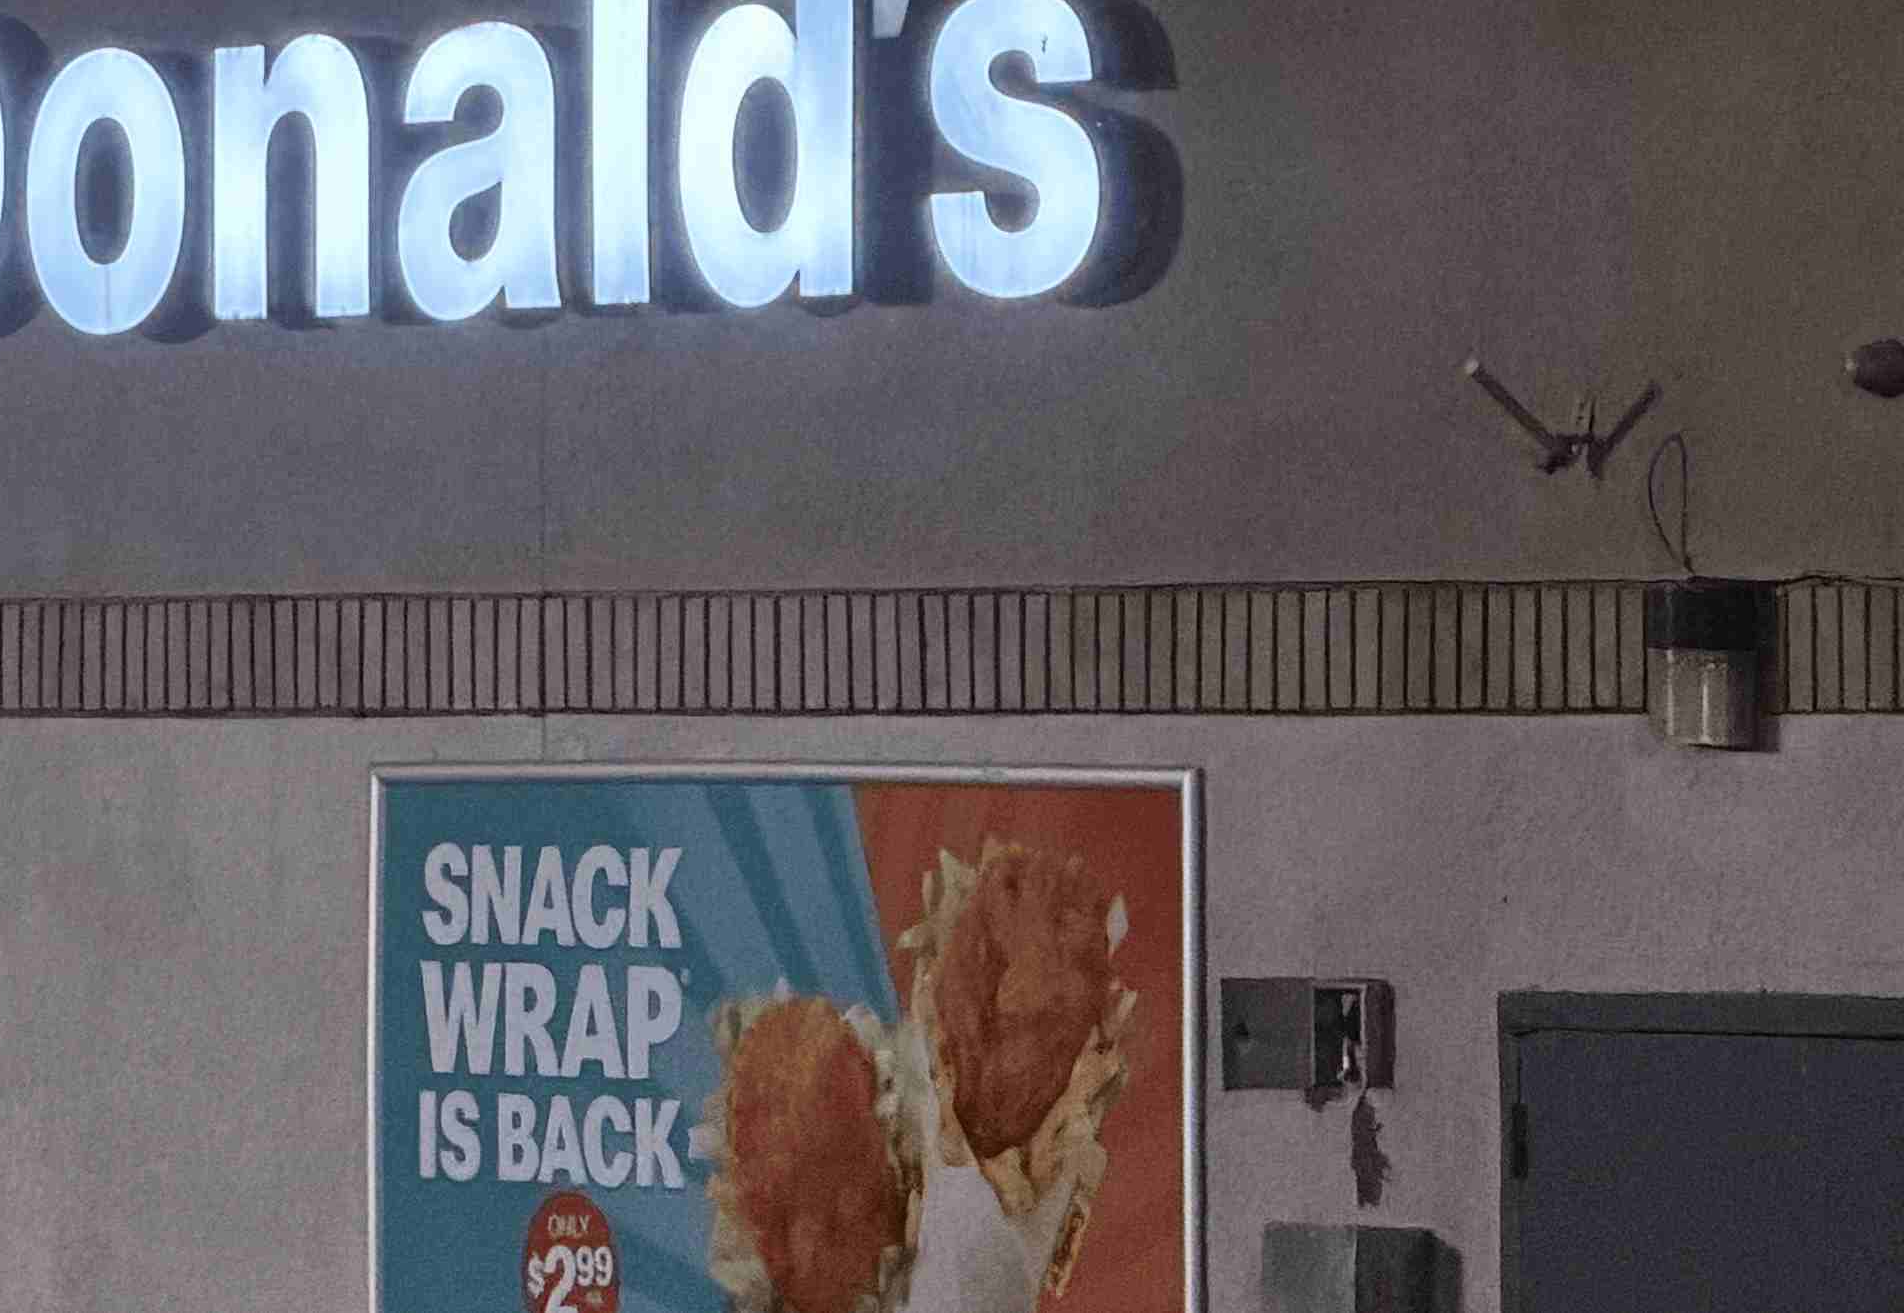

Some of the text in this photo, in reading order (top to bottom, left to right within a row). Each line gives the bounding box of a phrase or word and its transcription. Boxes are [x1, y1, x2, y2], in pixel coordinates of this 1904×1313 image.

[422, 842, 683, 949] SNACK
[419, 959, 683, 1079] WRAP
[418, 1088, 685, 1189] IS BACK
